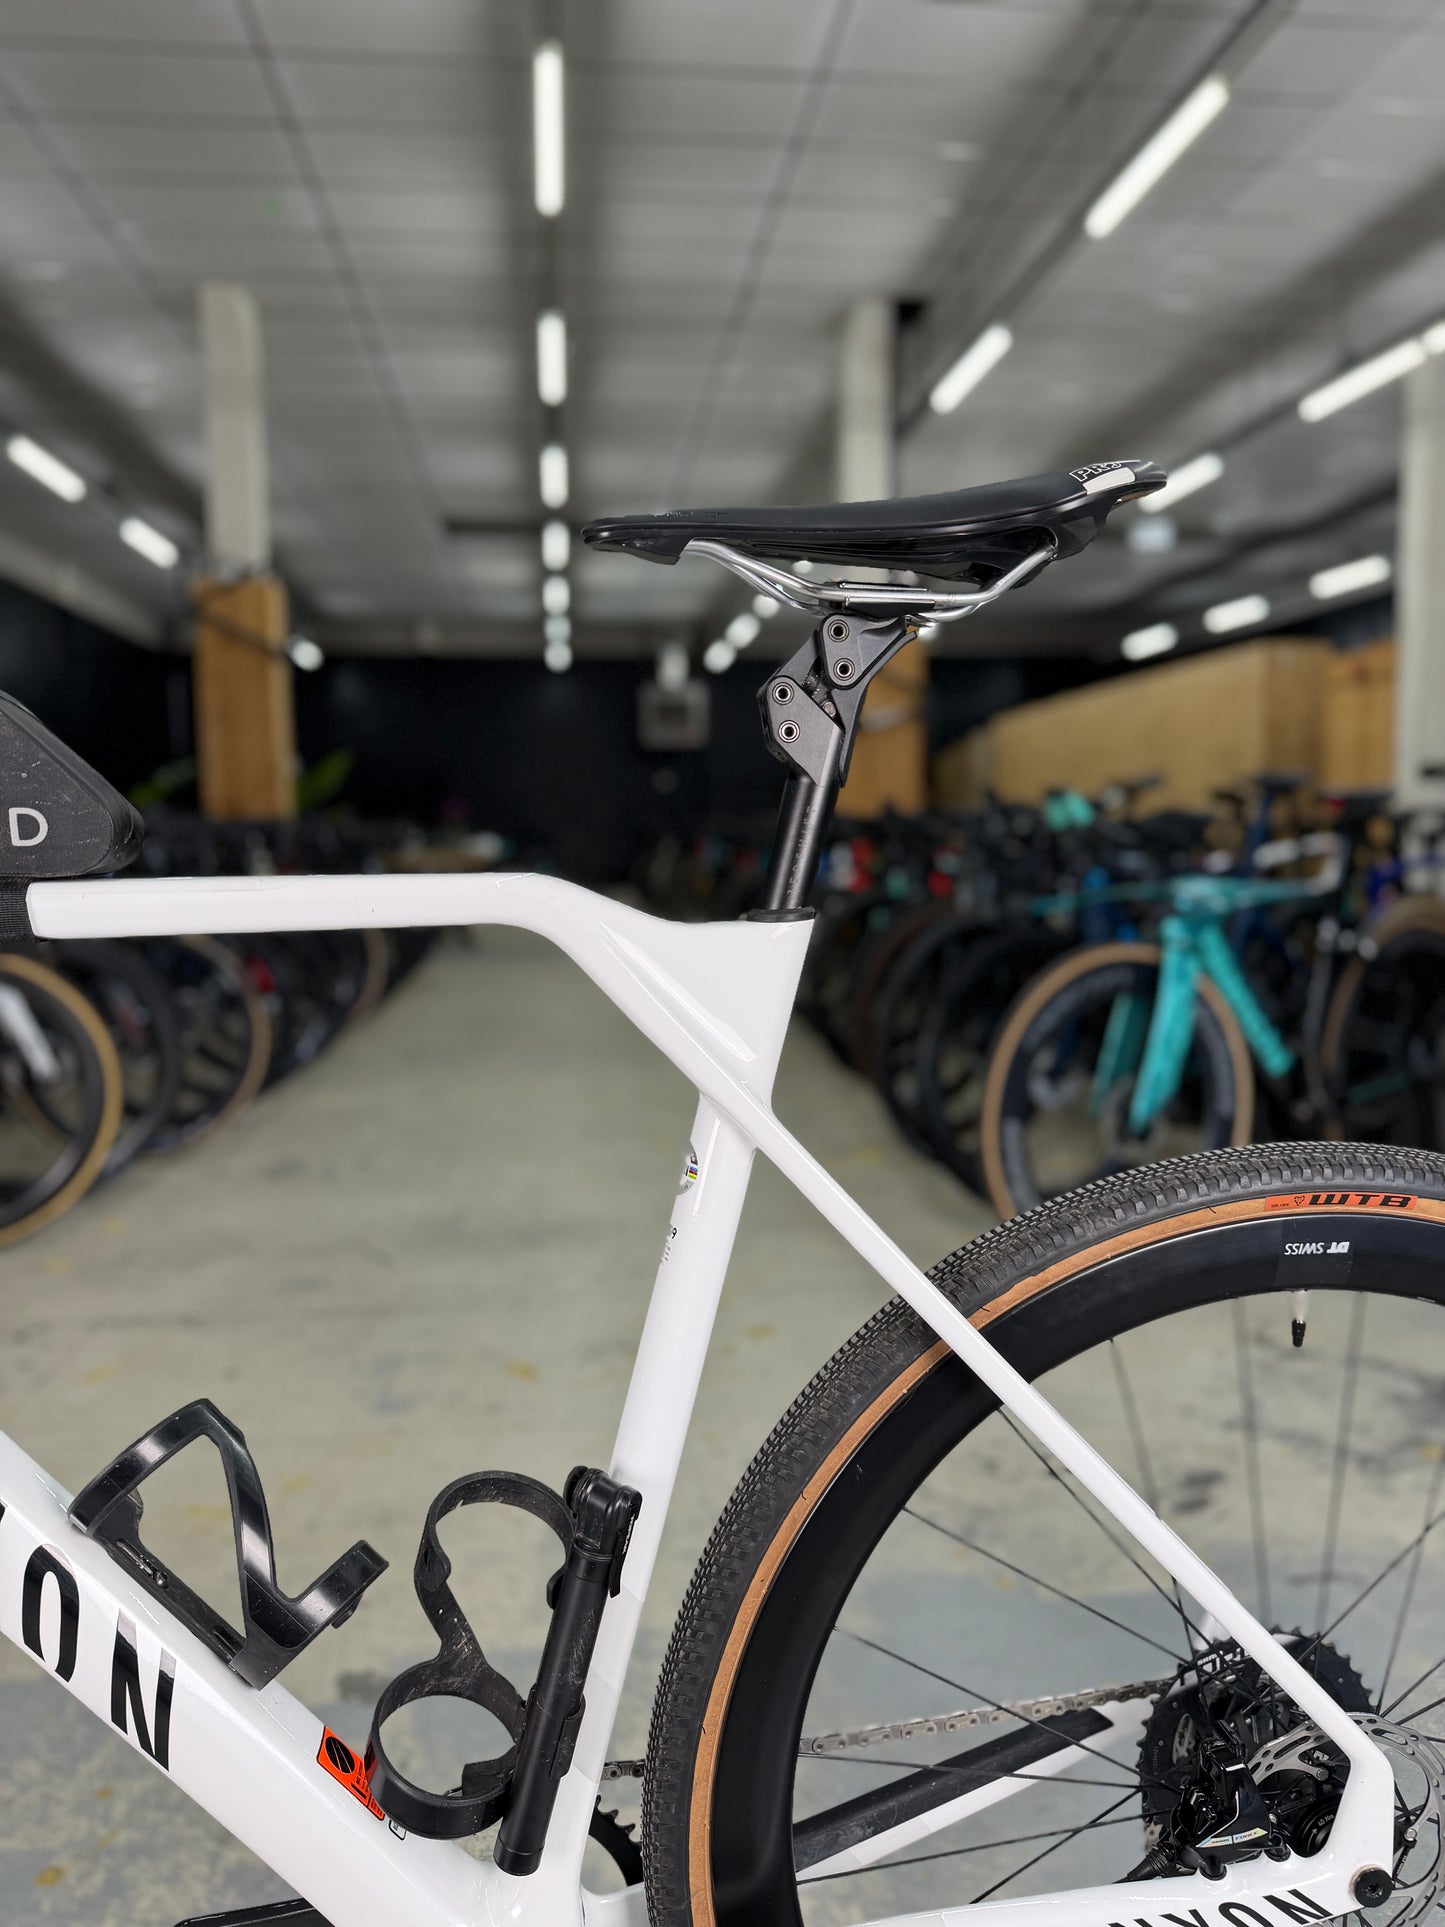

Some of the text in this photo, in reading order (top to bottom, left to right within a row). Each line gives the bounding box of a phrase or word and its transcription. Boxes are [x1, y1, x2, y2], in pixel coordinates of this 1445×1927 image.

[8, 807, 49, 847] D
[1309, 1193, 1412, 1208] WTB
[1283, 1241, 1350, 1256] DT SWISS
[0, 1503, 177, 1773] ON
